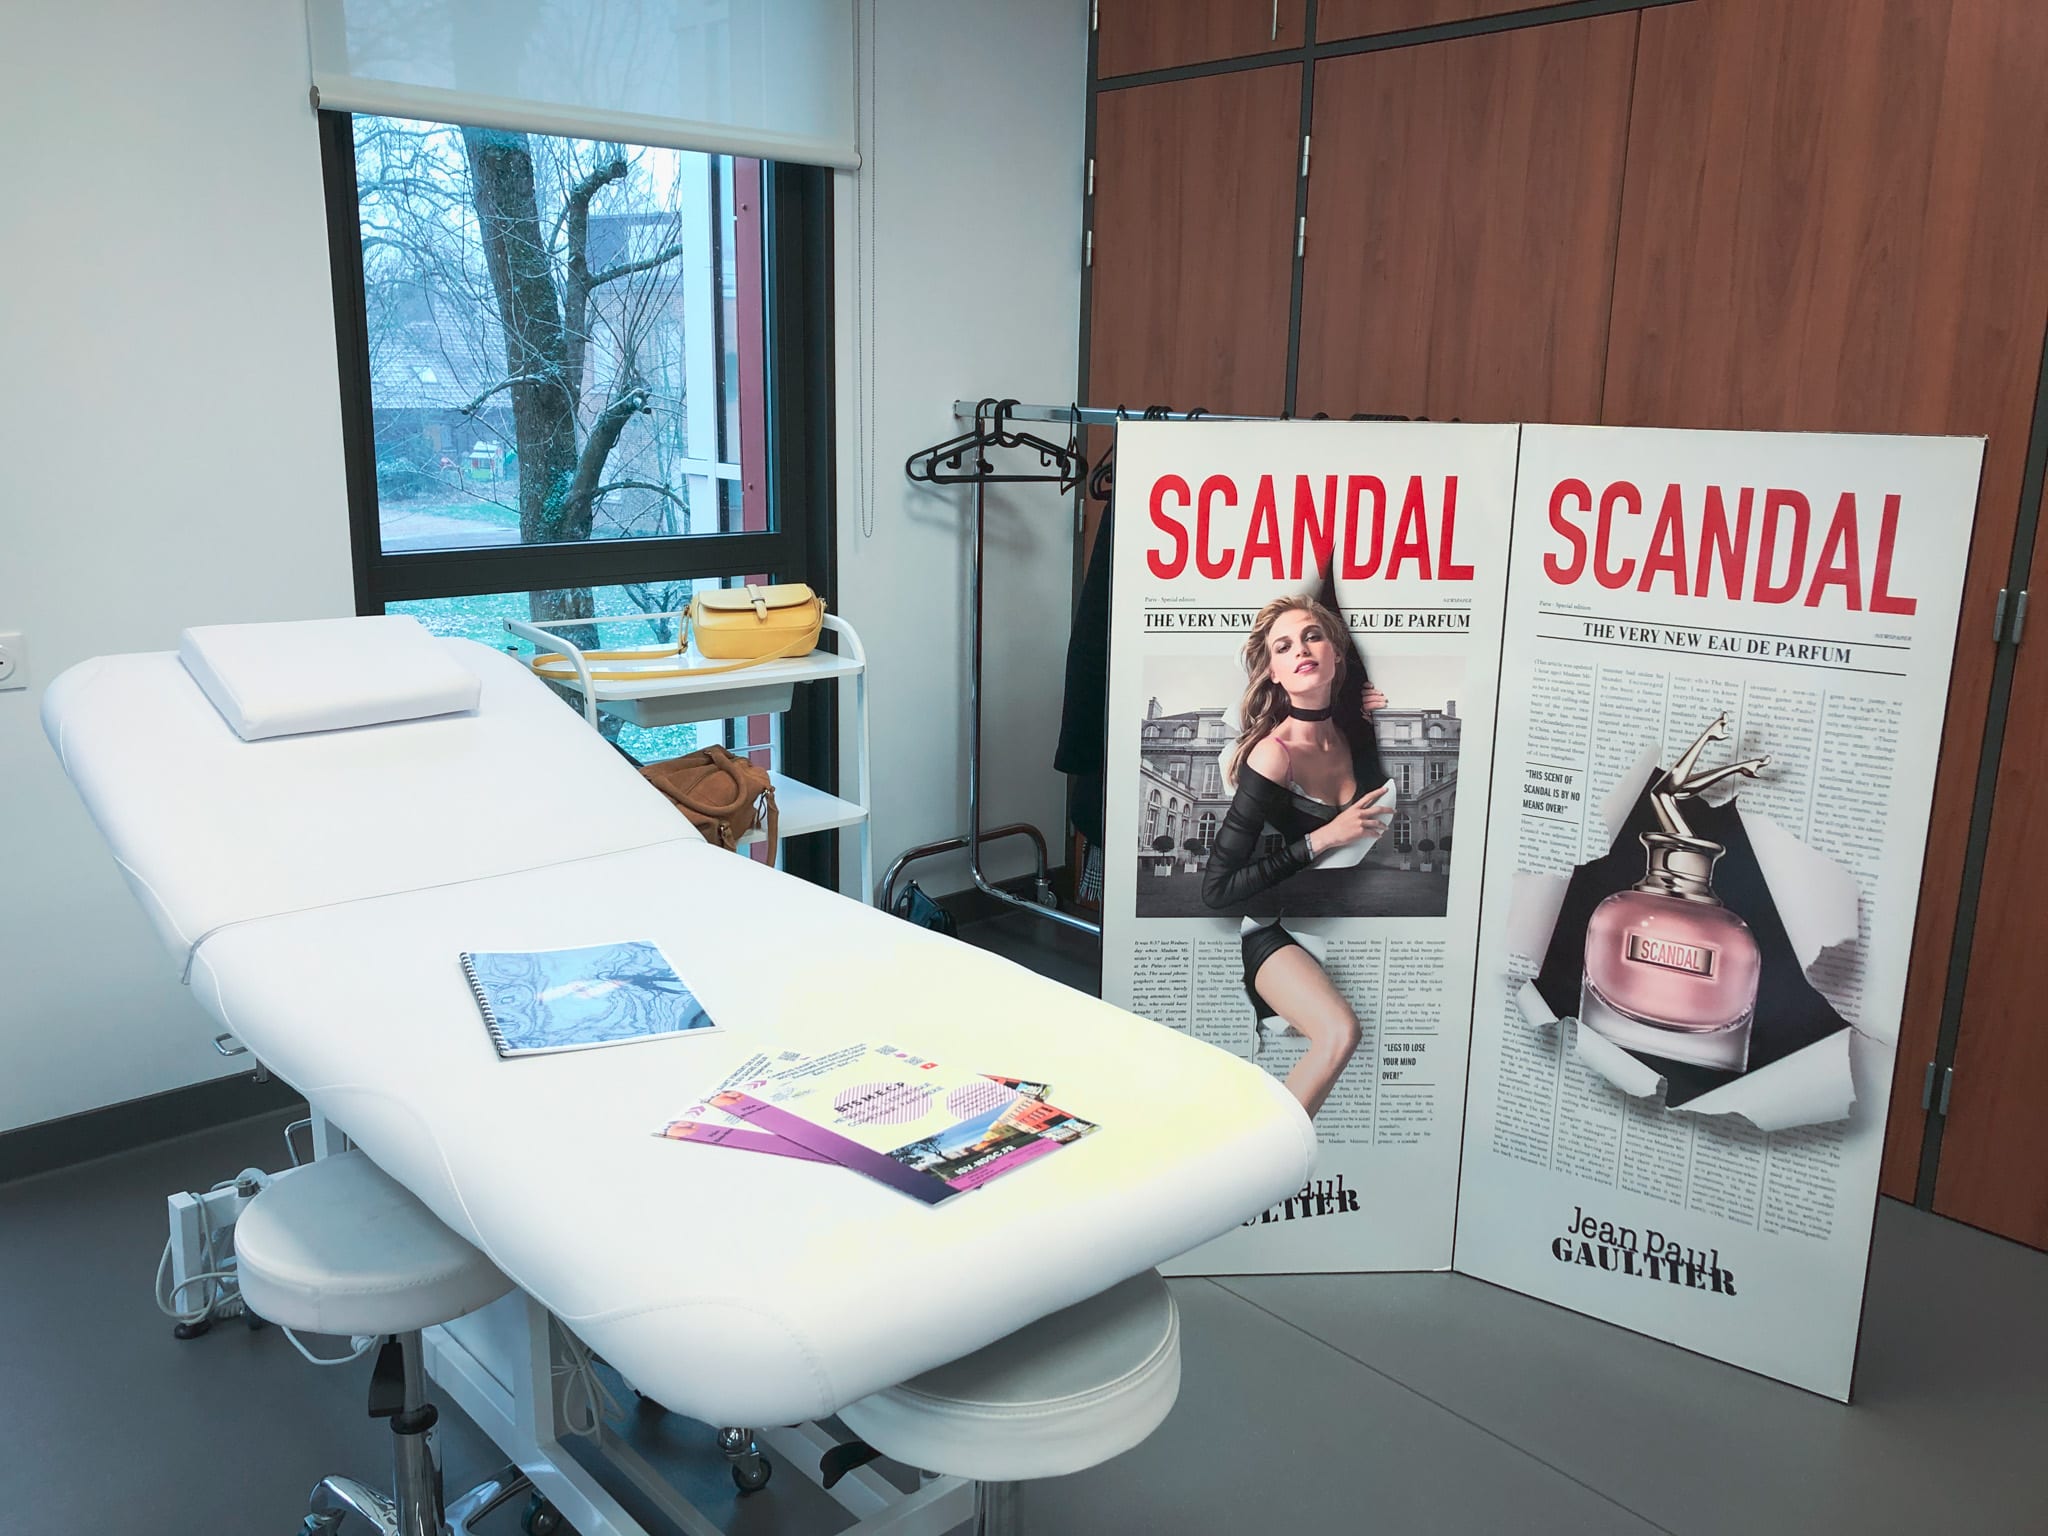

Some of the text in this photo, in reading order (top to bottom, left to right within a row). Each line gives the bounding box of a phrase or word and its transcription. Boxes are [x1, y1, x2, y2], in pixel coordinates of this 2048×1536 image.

[1146, 474, 1474, 580] SCANDAL
[1543, 478, 1917, 616] SCANDAL
[1144, 614, 1254, 627] THE VERY NEW
[1350, 614, 1470, 627] EAU DE PARFUM
[1584, 622, 1852, 665] THE VERY NEW EAU DE PARFUM
[1524, 784, 1580, 801] SCANDAL IS BY NO
[1544, 772, 1563, 782] SCENT
[1565, 775, 1573, 785] OF
[1523, 799, 1544, 810] MEANS
[1640, 940, 1700, 970] SCANDAL
[1297, 1174, 1345, 1200] aul
[1242, 1189, 1360, 1226] LTIER
[1568, 1206, 1639, 1253] Jean
[1552, 1237, 1737, 1296] GAULTIER
